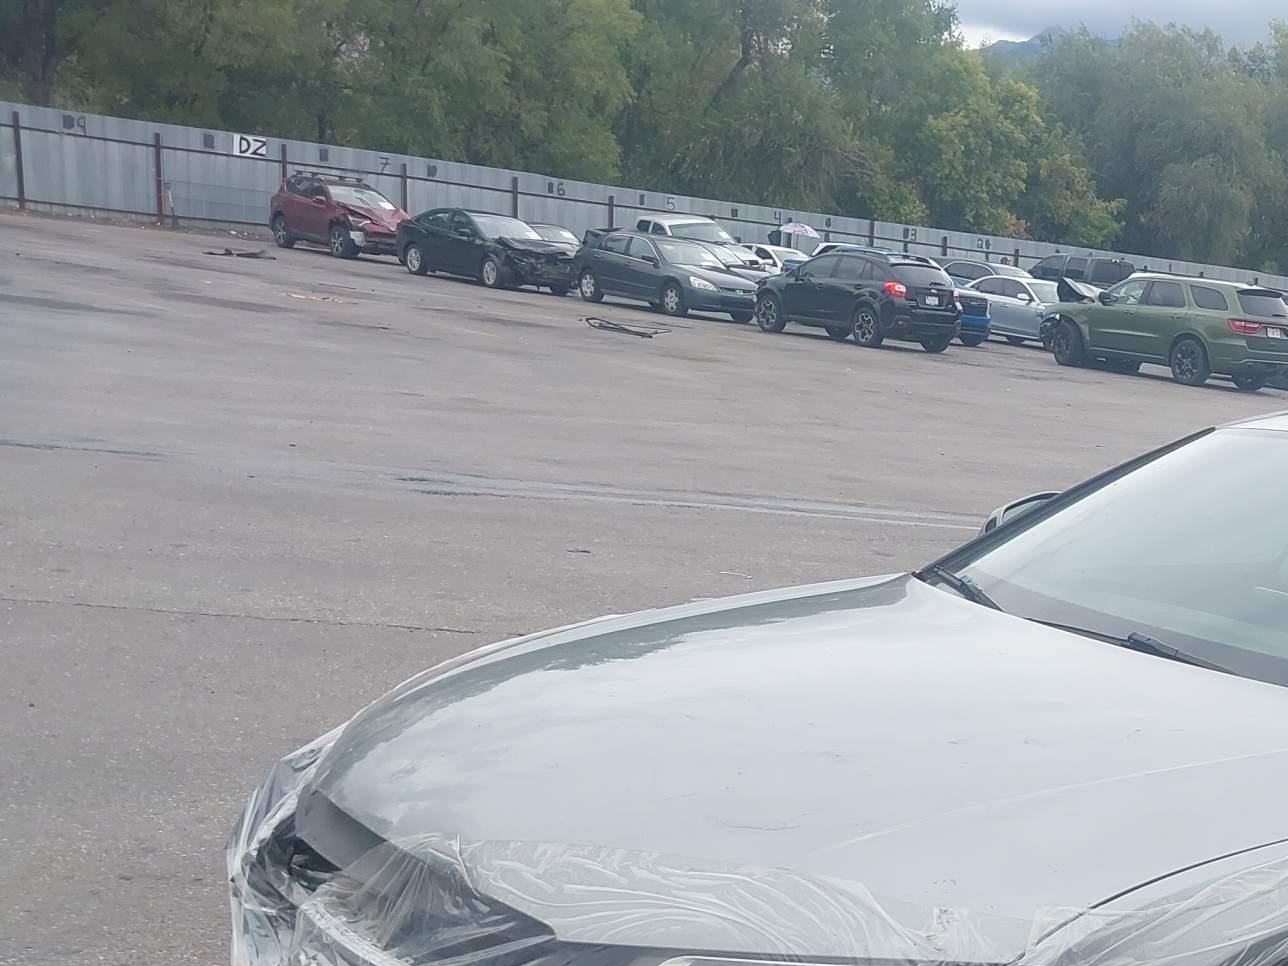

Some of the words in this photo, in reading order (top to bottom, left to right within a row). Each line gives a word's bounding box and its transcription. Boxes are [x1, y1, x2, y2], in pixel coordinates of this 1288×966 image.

[379, 156, 391, 174] 7
[556, 182, 566, 196] 6
[666, 197, 676, 211] 5
